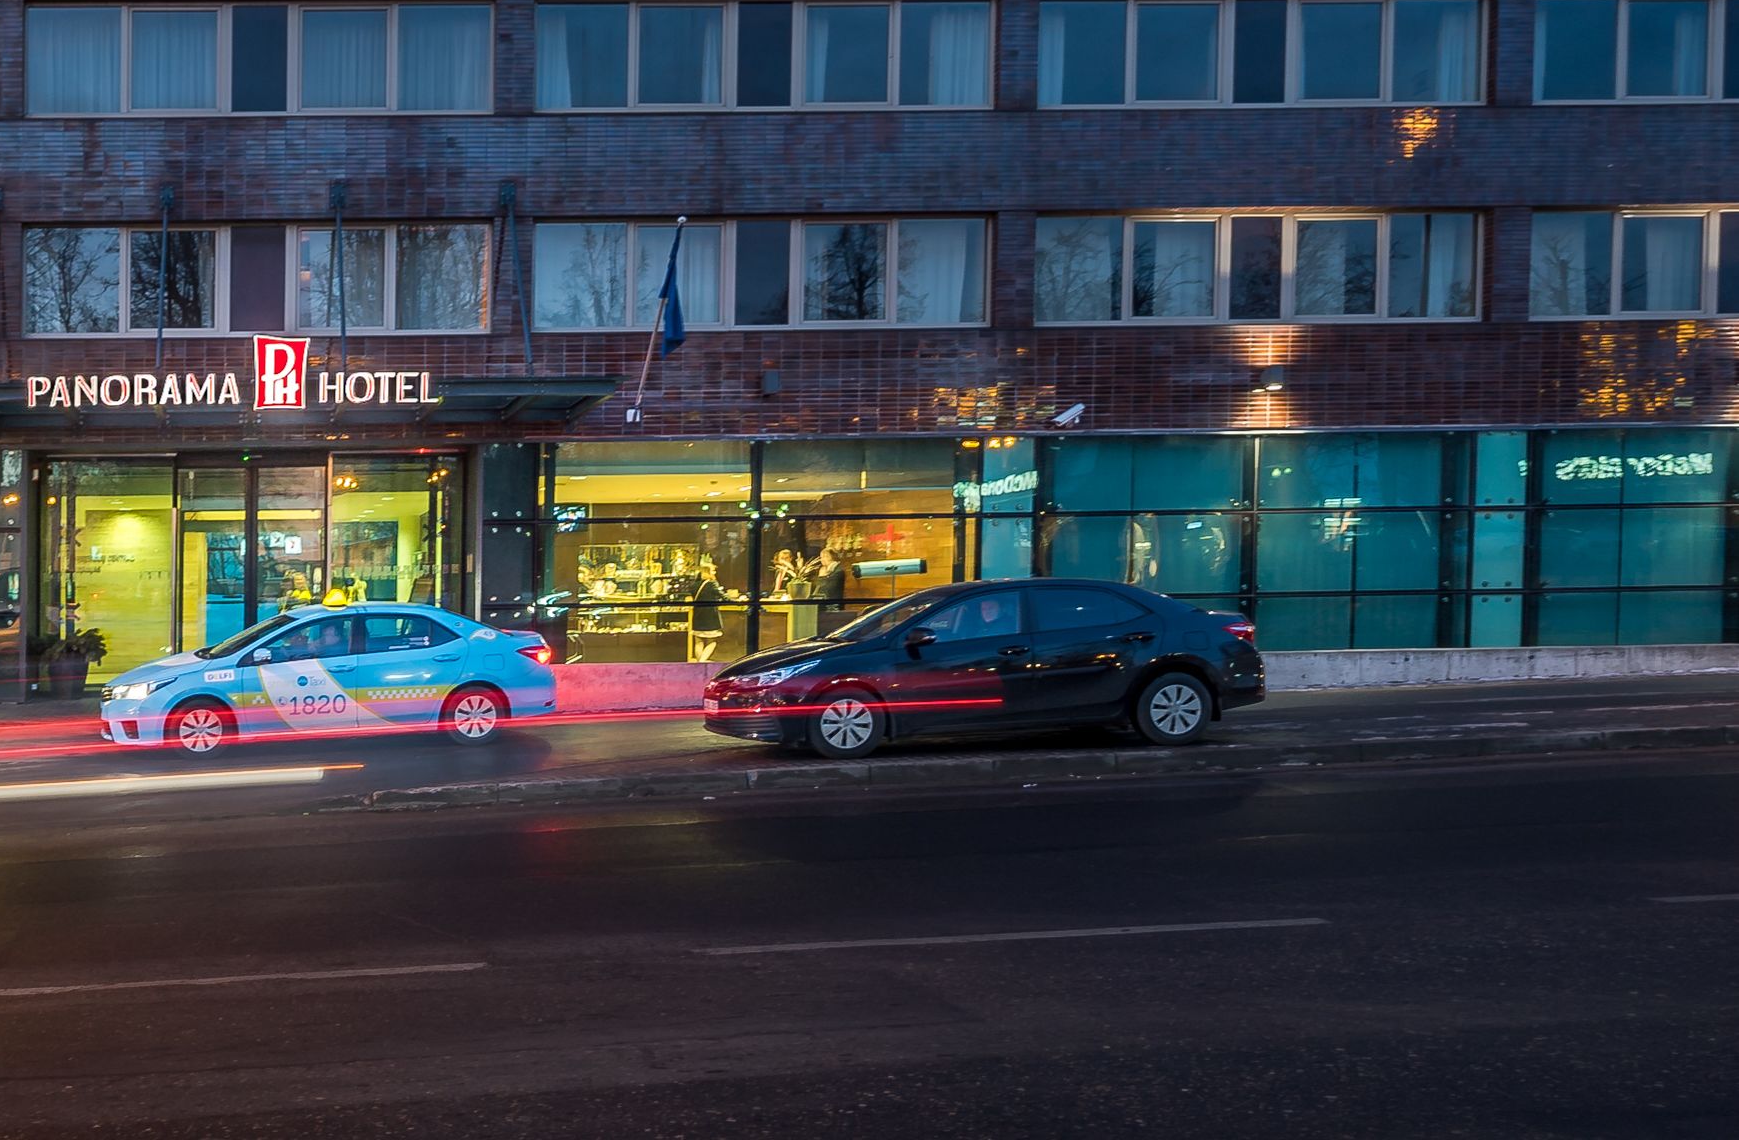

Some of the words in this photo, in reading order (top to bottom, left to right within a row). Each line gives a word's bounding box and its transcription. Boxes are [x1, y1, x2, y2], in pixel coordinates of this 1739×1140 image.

[26, 373, 241, 408] PANORAMA
[319, 371, 440, 404] HOTEL
[207, 673, 233, 682] DELFI
[308, 675, 327, 686] Taxi
[289, 693, 347, 716] 1820
